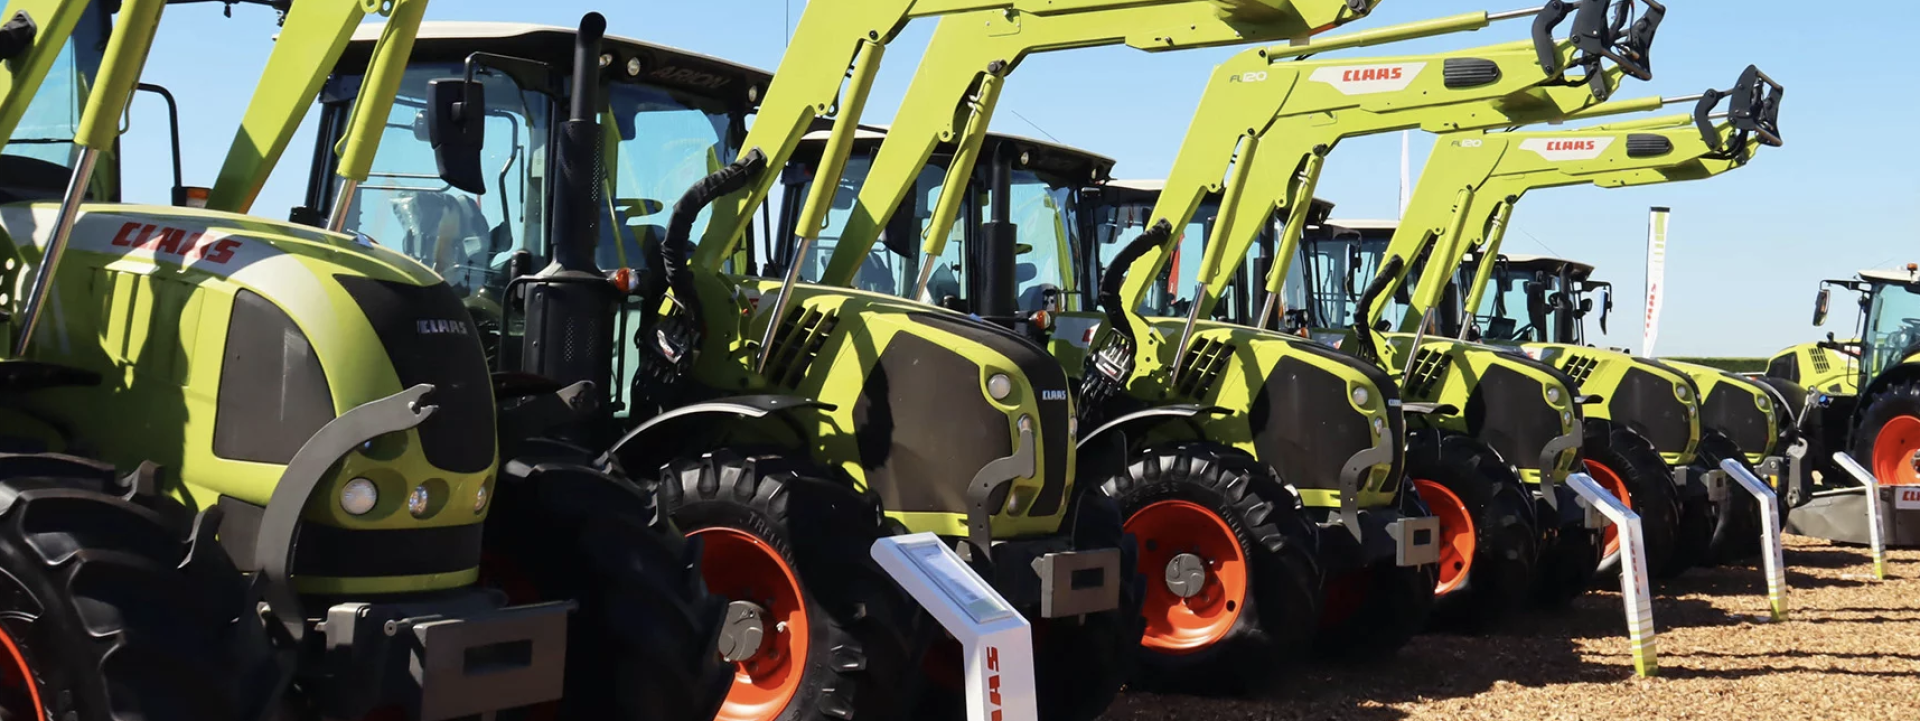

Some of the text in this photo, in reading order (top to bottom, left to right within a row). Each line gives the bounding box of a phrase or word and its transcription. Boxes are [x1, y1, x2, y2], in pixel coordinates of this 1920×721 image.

[1229, 71, 1268, 83] FL120
[1342, 67, 1402, 82] CLAAS
[1546, 140, 1595, 151] CLAAS
[111, 222, 242, 264] CLAAS
